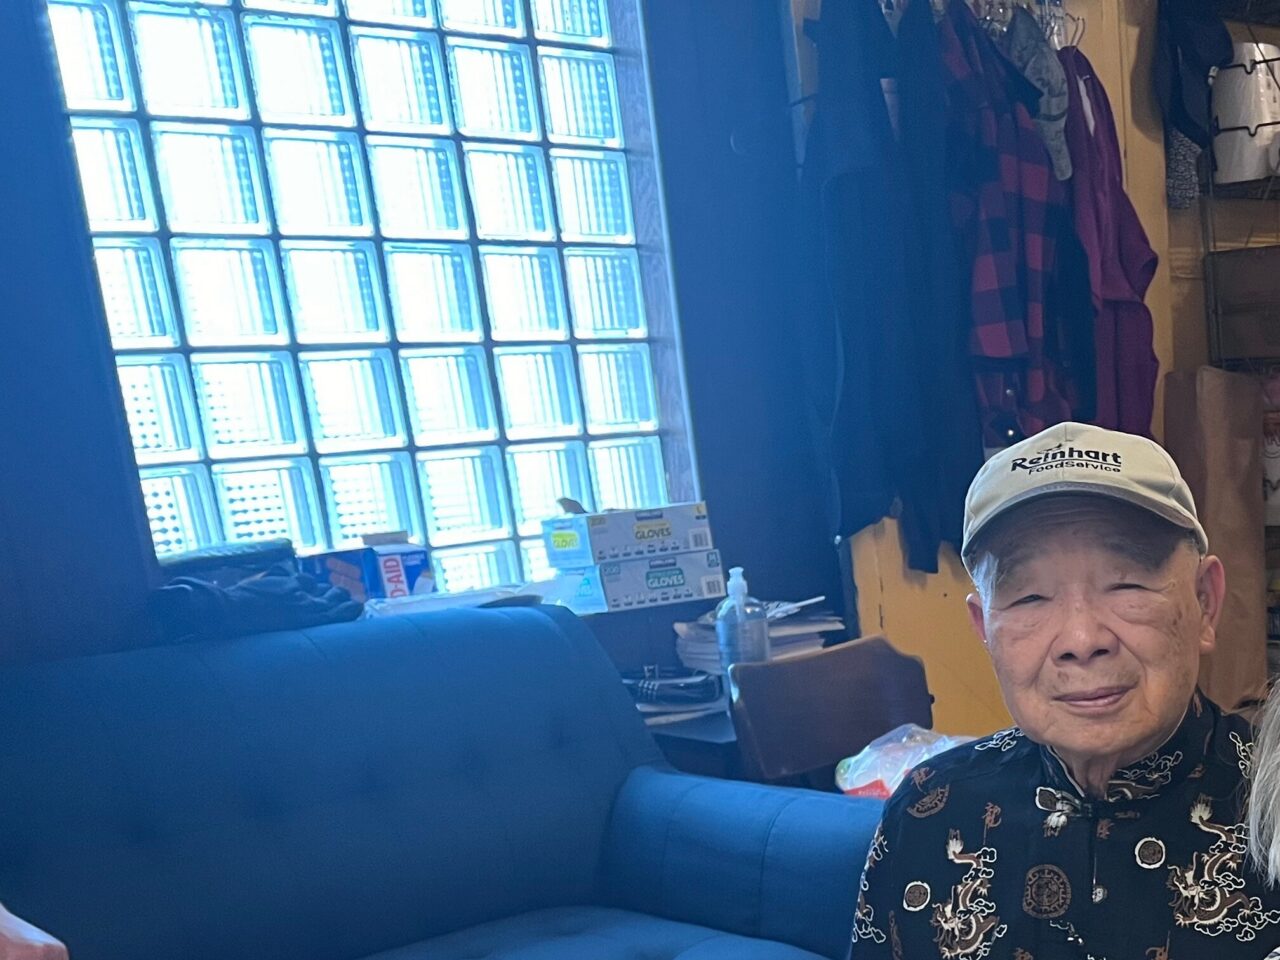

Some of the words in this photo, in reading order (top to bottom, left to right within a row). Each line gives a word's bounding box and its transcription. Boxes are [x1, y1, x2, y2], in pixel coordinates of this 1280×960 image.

[1011, 447, 1122, 472] Reinhart
[1028, 459, 1122, 475] FoodService
[634, 527, 673, 541] GLOVES
[647, 574, 684, 588] GLOVES
